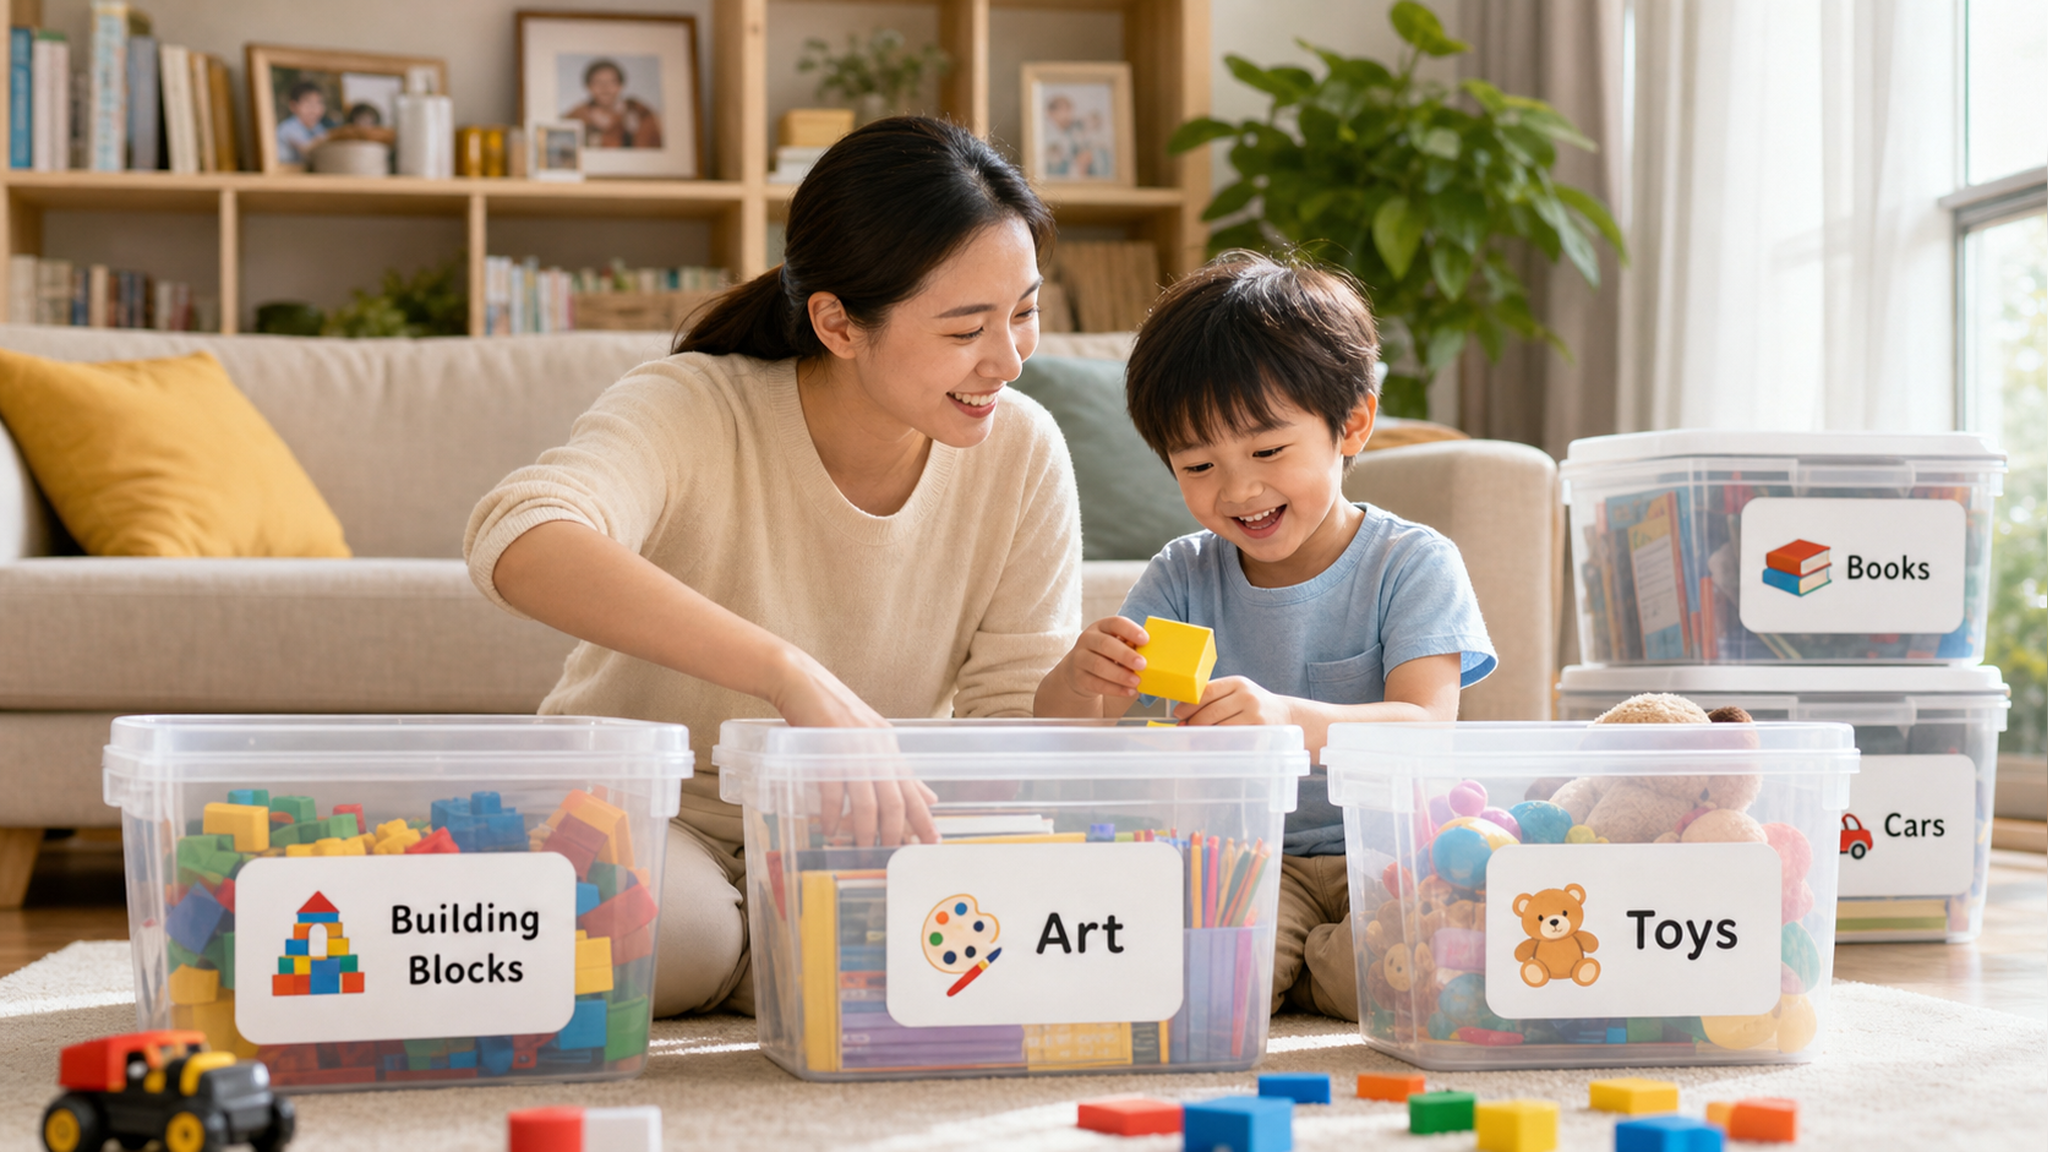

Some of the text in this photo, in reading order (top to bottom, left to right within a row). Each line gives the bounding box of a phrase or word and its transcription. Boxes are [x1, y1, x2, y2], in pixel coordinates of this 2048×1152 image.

[1847, 554, 1930, 580] Books
[1884, 812, 1945, 838] Cars
[392, 902, 540, 941] Building
[1036, 912, 1125, 955] Art
[1626, 910, 1738, 962] Toys
[409, 952, 524, 985] Blocks
